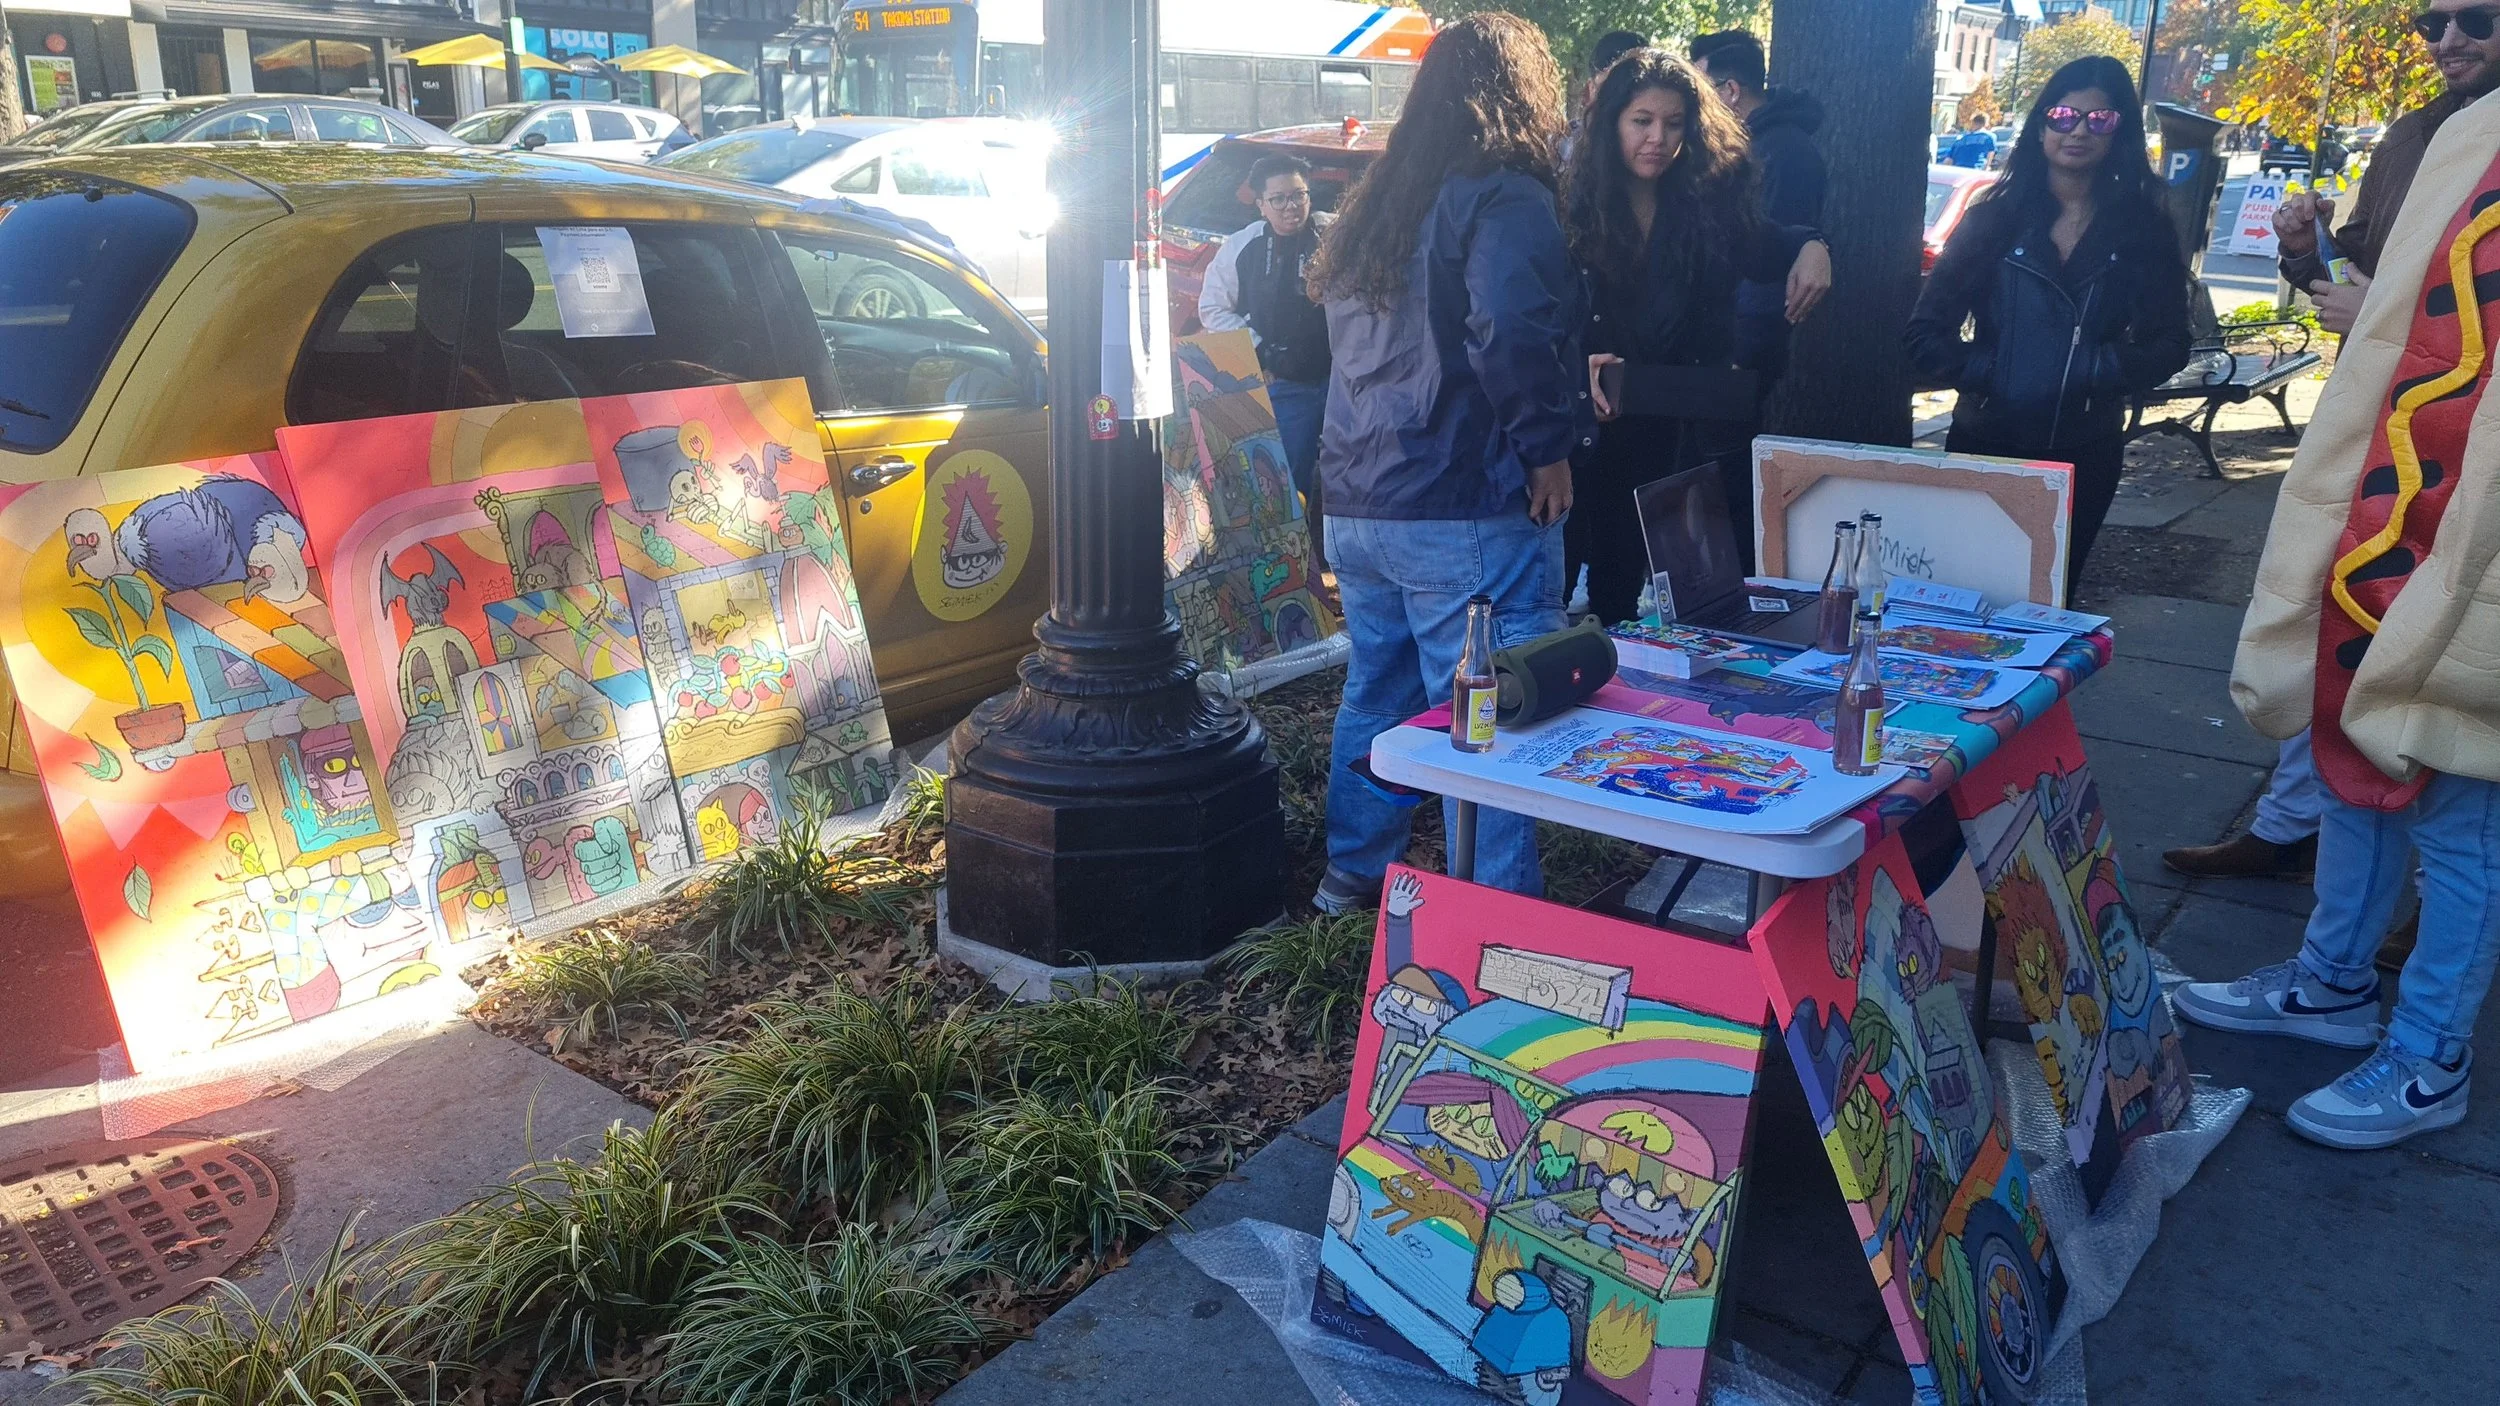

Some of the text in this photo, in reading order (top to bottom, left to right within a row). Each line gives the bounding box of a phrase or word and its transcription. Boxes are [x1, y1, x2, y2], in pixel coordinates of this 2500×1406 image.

[854, 8, 950, 31] 54 TAKOMA STATION
[2168, 152, 2190, 180] P
